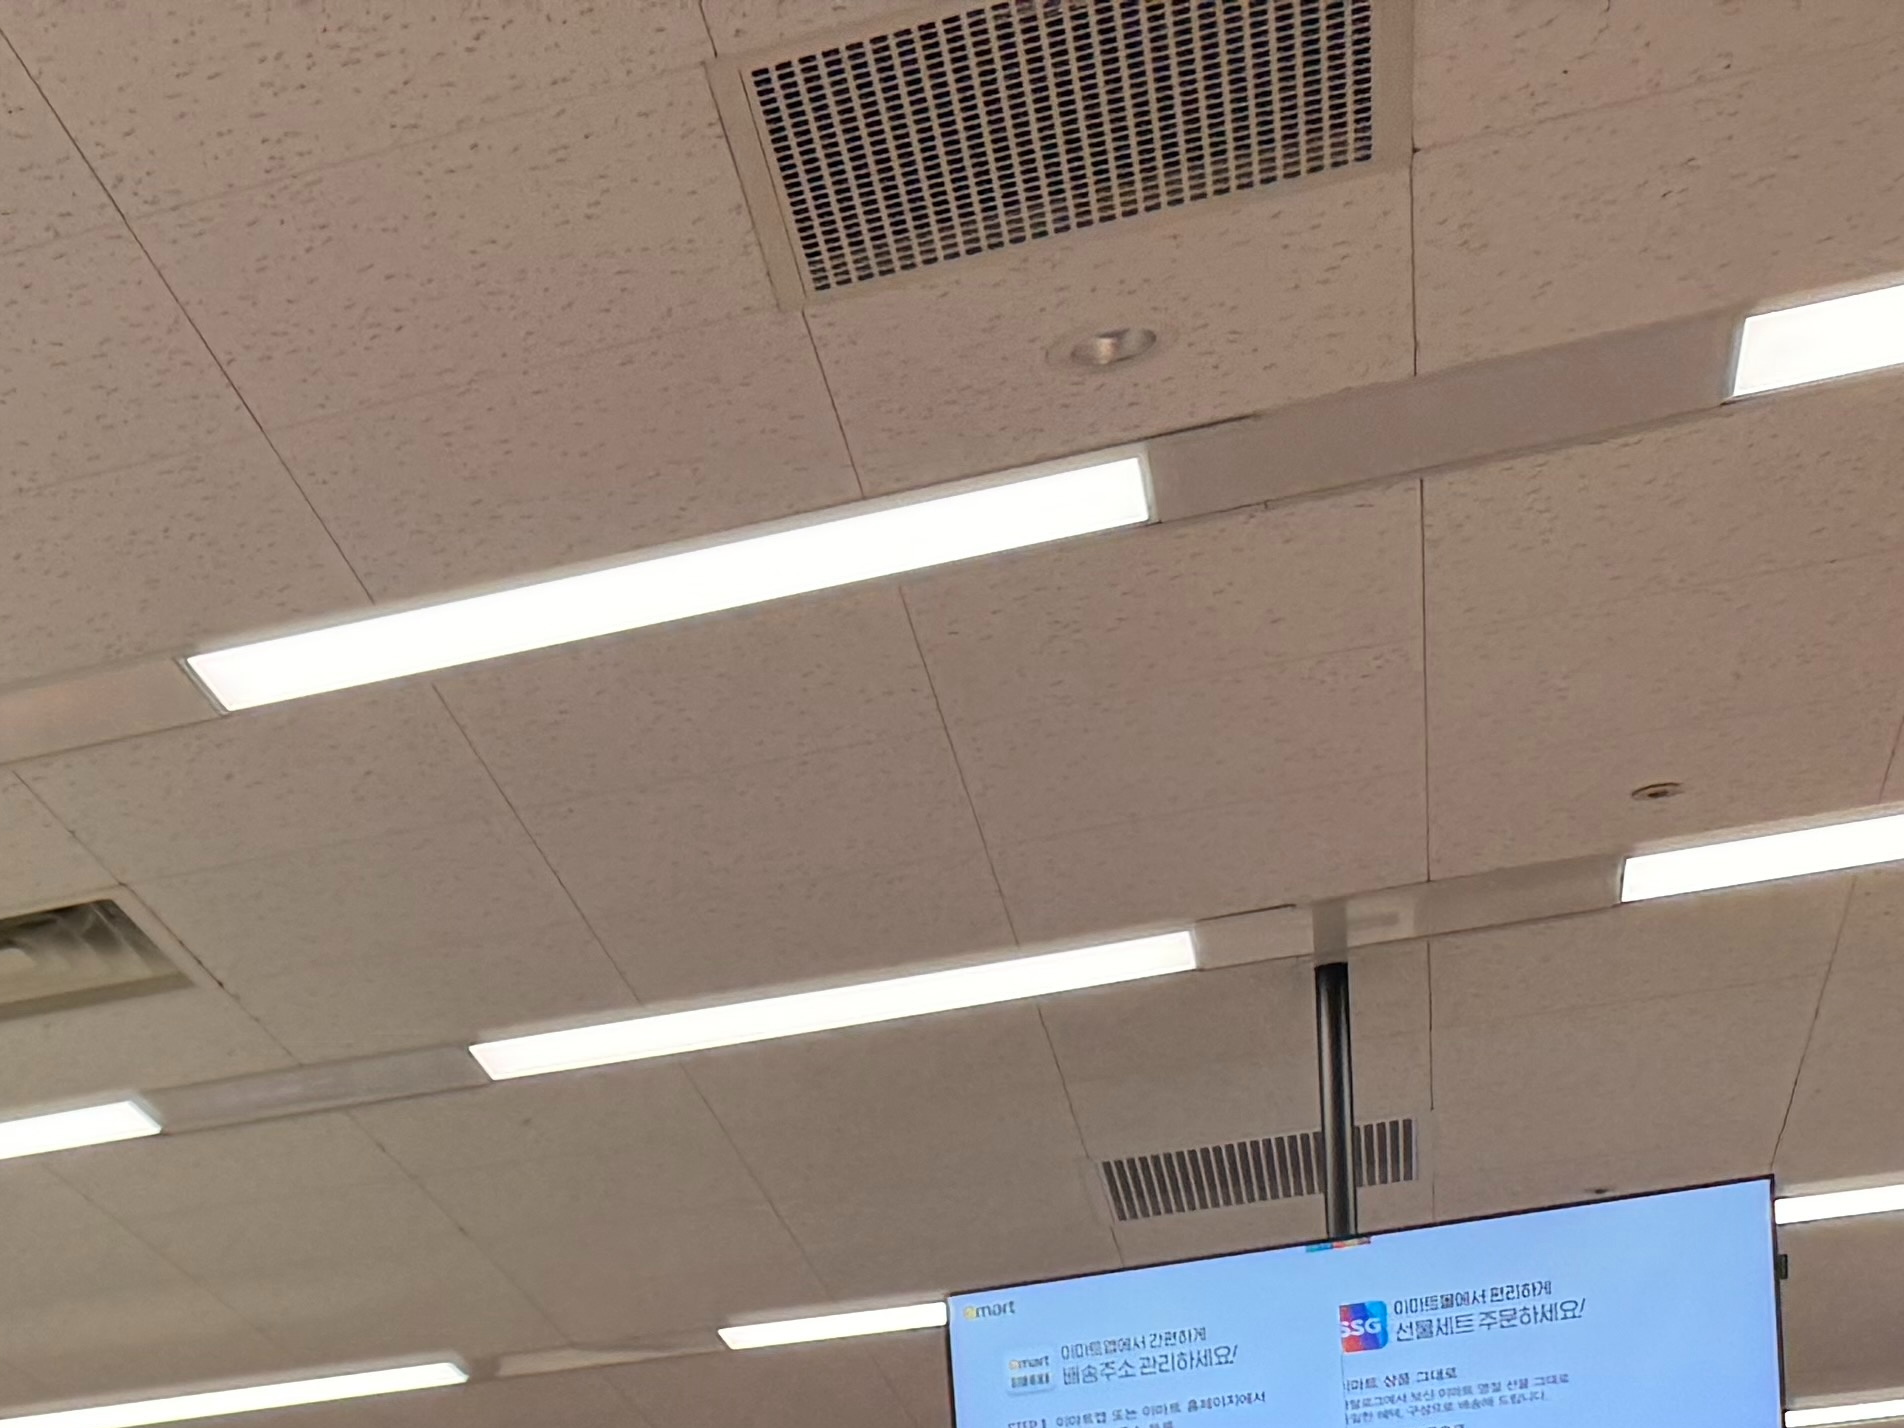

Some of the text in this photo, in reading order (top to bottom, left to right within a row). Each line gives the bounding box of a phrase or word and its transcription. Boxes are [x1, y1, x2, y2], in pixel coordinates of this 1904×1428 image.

[1490, 1280, 1552, 1301] 편리하게
[1340, 1317, 1382, 1338] SSG
[1396, 1298, 1586, 1342] 선물세트 주문하세요!
[1060, 1327, 1208, 1360] 이마트앱에서 간편하게
[1062, 1345, 1239, 1386] 배송주소 관리하세요!
